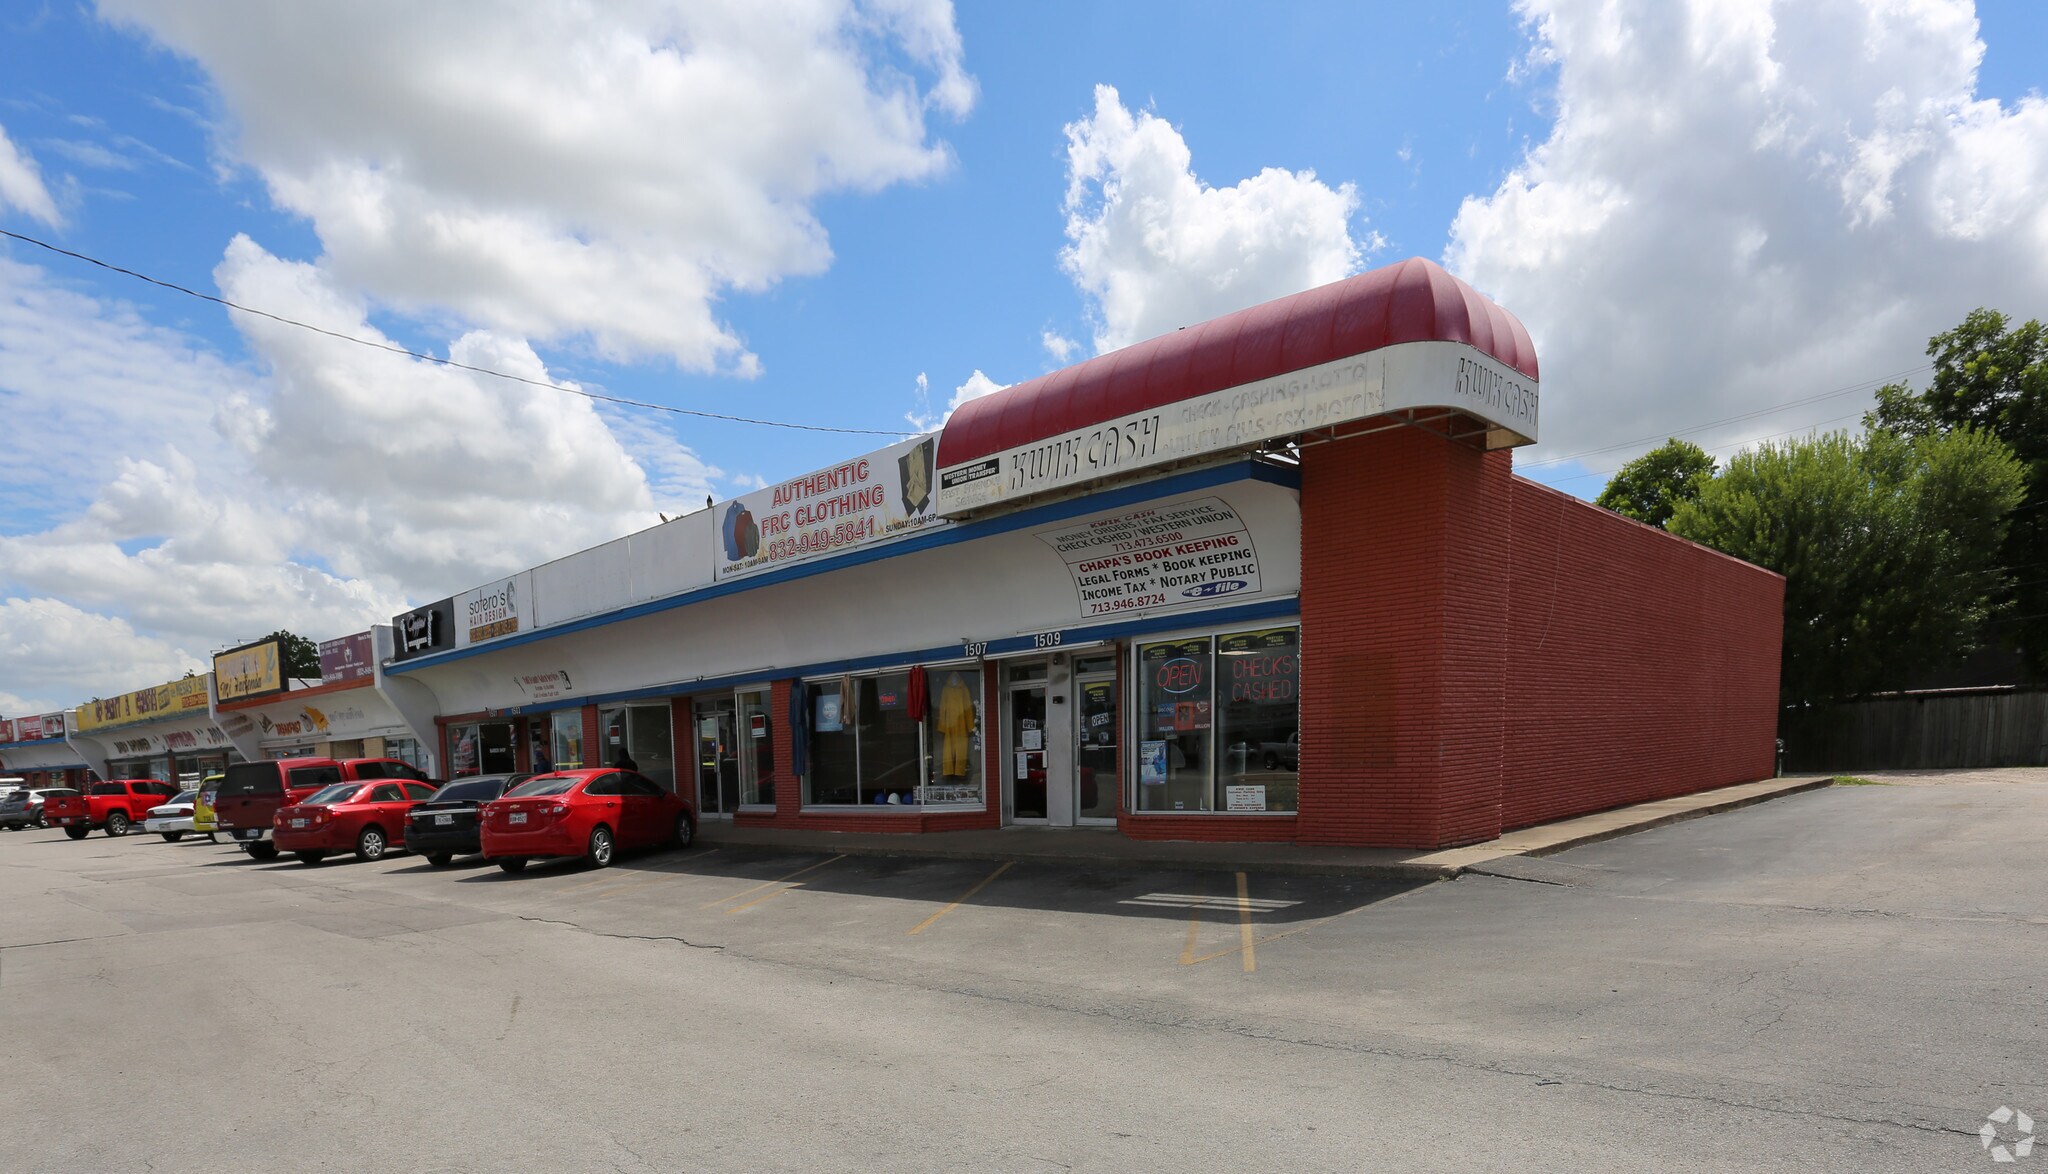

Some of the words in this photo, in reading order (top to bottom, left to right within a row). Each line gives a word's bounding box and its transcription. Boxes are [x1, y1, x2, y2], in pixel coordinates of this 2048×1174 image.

[1231, 380, 1300, 412] CASHING
[1311, 362, 1366, 391] LOTTO
[1456, 357, 1502, 409] KWIK
[1504, 381, 1539, 427] CASH
[1008, 437, 1081, 490] KWIK
[1088, 415, 1160, 469] CASH
[943, 469, 967, 480] WESTERN
[968, 462, 987, 474] MONEY
[951, 475, 968, 485] UNION
[968, 467, 996, 480] TRANSFER
[771, 458, 870, 509] AUTHENTIC
[761, 511, 790, 538] FRC
[795, 484, 885, 527] CLOTHING
[1090, 517, 1123, 529] KWIK
[1124, 510, 1156, 522] CASH
[1056, 530, 1094, 543] MONEY
[1094, 522, 1136, 538] ORDERS
[1143, 514, 1165, 526] FAX
[1166, 505, 1216, 521] SERVICE
[1057, 540, 1089, 553] CHECK
[1090, 530, 1132, 547] CASHED
[1140, 520, 1191, 538] WESTERN
[1192, 510, 1234, 526] UNION
[768, 514, 875, 562] 832-949-5841
[1112, 531, 1183, 552] 713.473.6500
[1079, 555, 1132, 573] CHAPA'S
[1136, 547, 1173, 563] BOOK
[1175, 535, 1239, 555] KEEPING
[469, 589, 506, 615] sotero's
[1090, 592, 1166, 613] 713.946.8724
[469, 614, 483, 627] HAIR
[485, 607, 507, 622] DESIGN
[965, 642, 987, 656] 1507
[1033, 631, 1061, 648] 1509
[1156, 663, 1204, 688] OPEN
[1233, 655, 1293, 679] CHECKS
[1232, 679, 1291, 702] CASHED
[1023, 719, 1036, 728] OPEN
[1092, 713, 1109, 726] OPEN
